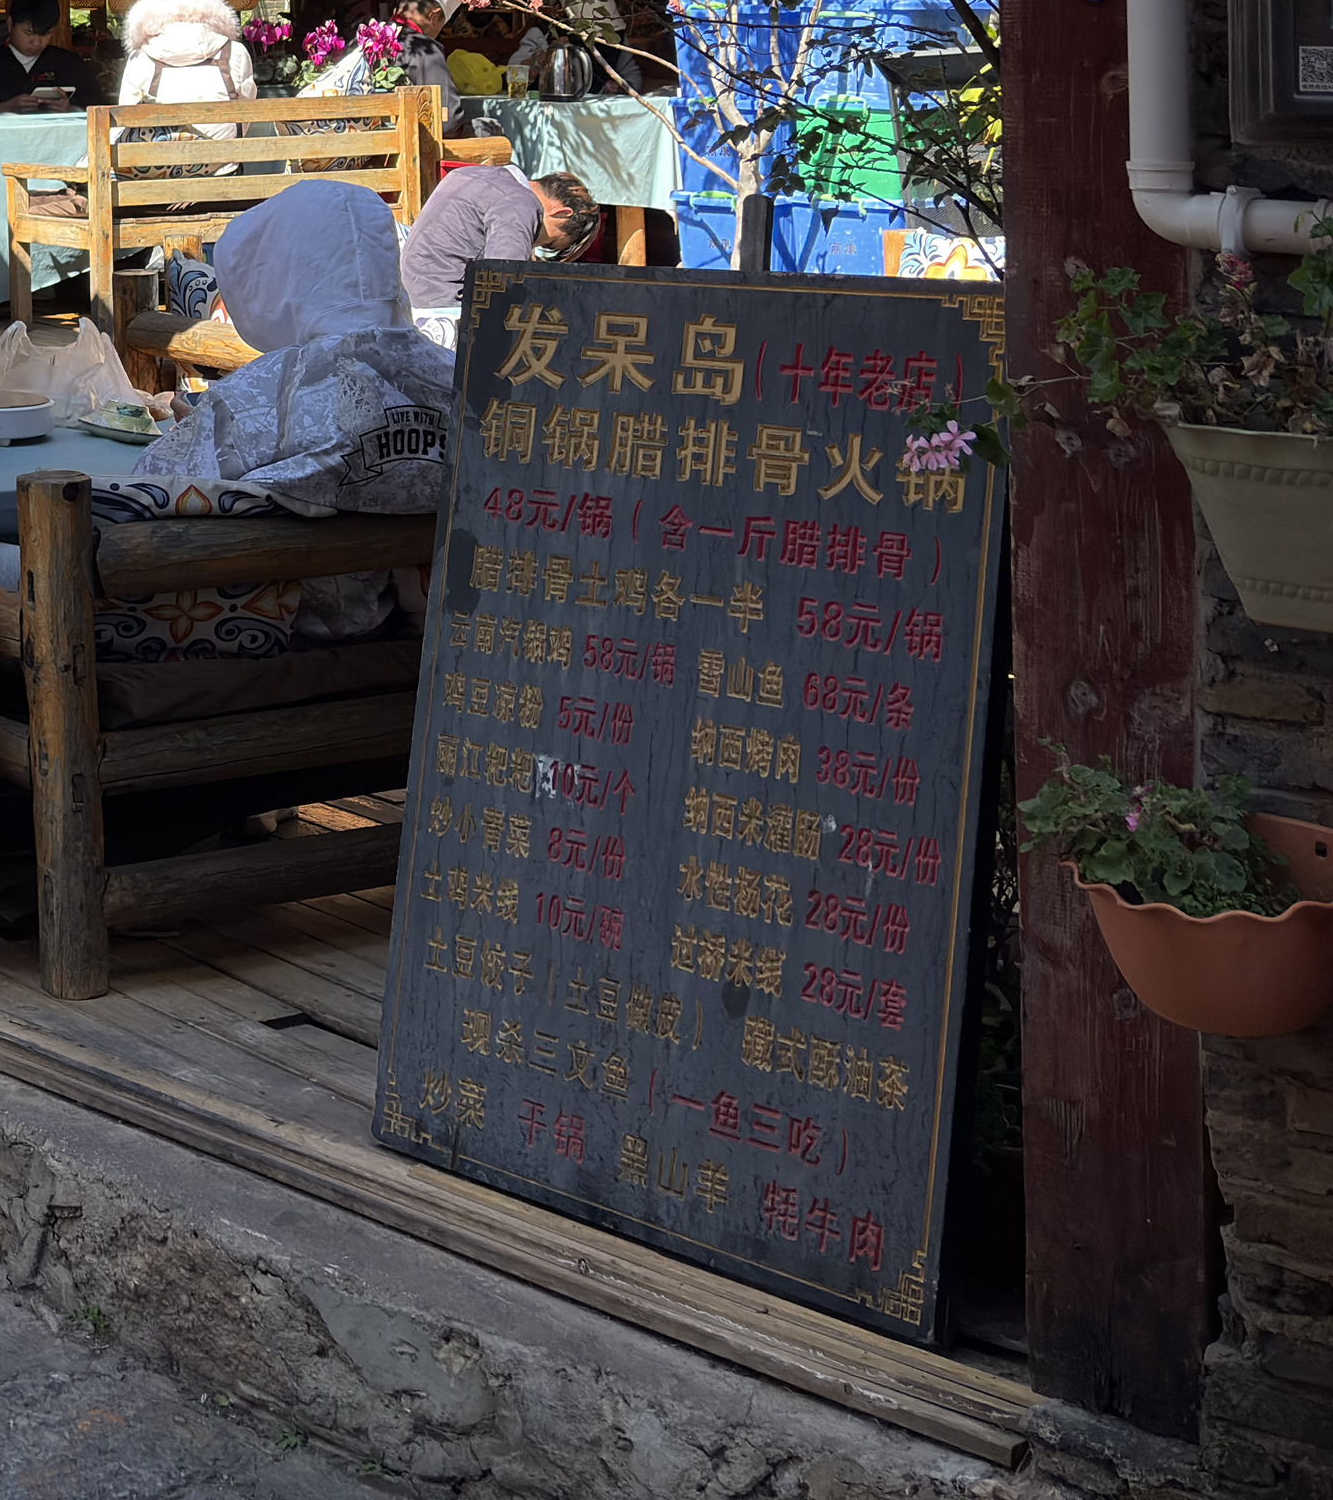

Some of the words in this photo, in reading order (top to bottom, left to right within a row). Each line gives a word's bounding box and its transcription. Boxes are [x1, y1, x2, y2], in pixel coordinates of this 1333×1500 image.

[493, 303, 744, 406] 发呆岛
[391, 411, 411, 424] LIVE
[413, 410, 435, 425] WITH
[480, 397, 966, 514] 铜锅腊排骨火锅
[449, 609, 573, 670] 云南汽锅鸡
[583, 634, 676, 688] 58元/锅
[469, 543, 764, 633] 腊排骨土鸡各一半
[796, 596, 944, 663] 58元/锅
[443, 671, 544, 729] 鸡豆凉粉
[557, 695, 635, 746] 5元/份
[698, 649, 784, 708] 雪山鱼
[803, 672, 915, 731] 68元/条
[436, 732, 535, 794] 丽江粑粑
[549, 760, 636, 816] 10元/个
[690, 715, 801, 783] 纳西烤肉
[815, 745, 921, 806] 38元/份
[428, 795, 533, 859] 炒小青菜
[547, 827, 627, 881] 8元/份
[684, 786, 822, 860] 纳西米灌肠
[838, 824, 942, 886] 28元/份
[421, 859, 520, 924] 土鸡米线
[535, 892, 625, 950] 10元/碗
[677, 855, 793, 927] 水性杨花
[805, 889, 911, 955] 28元/份
[671, 923, 787, 998] 过桥米线
[801, 961, 908, 1031] 28元/套
[461, 1008, 630, 1101] 现杀三文鱼
[741, 1015, 910, 1112] 藏式酥油茶
[419, 1067, 487, 1131] 炒菜
[517, 1099, 585, 1166] 干锅
[617, 1132, 730, 1214] 黑山羊
[761, 1180, 883, 1272] 牦牛肉
